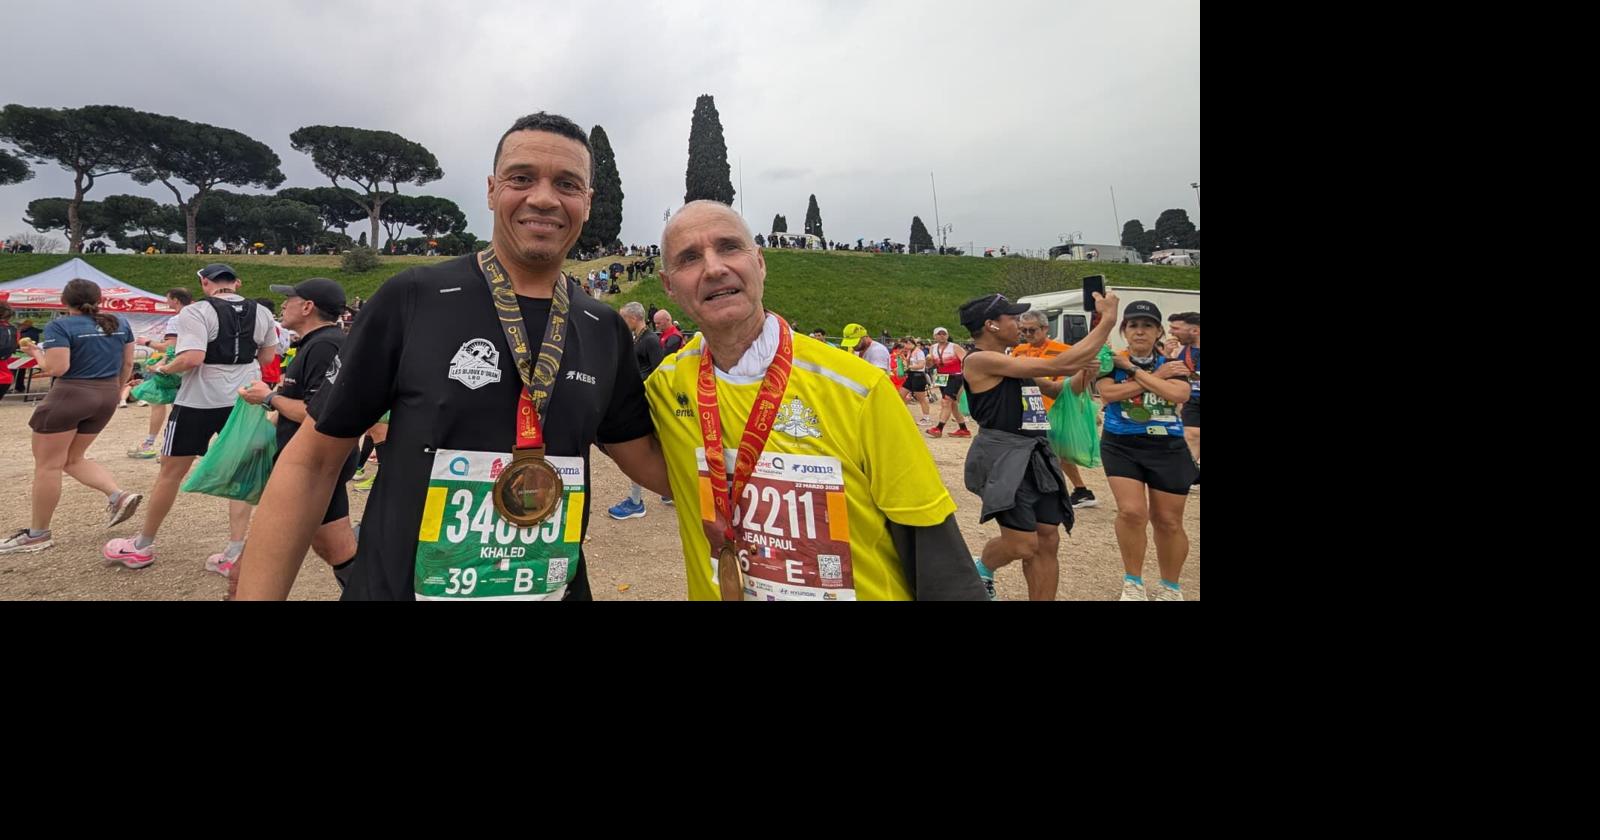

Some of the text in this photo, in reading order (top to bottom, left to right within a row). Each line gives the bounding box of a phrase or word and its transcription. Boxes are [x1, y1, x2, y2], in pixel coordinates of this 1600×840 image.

[576, 371, 596, 385] KEBS
[732, 484, 817, 540] 2211
[480, 547, 526, 559] KHALED
[742, 532, 797, 552] JEAN PAUL
[445, 567, 478, 595] 39
[514, 568, 534, 593] B
[785, 559, 805, 584] E
